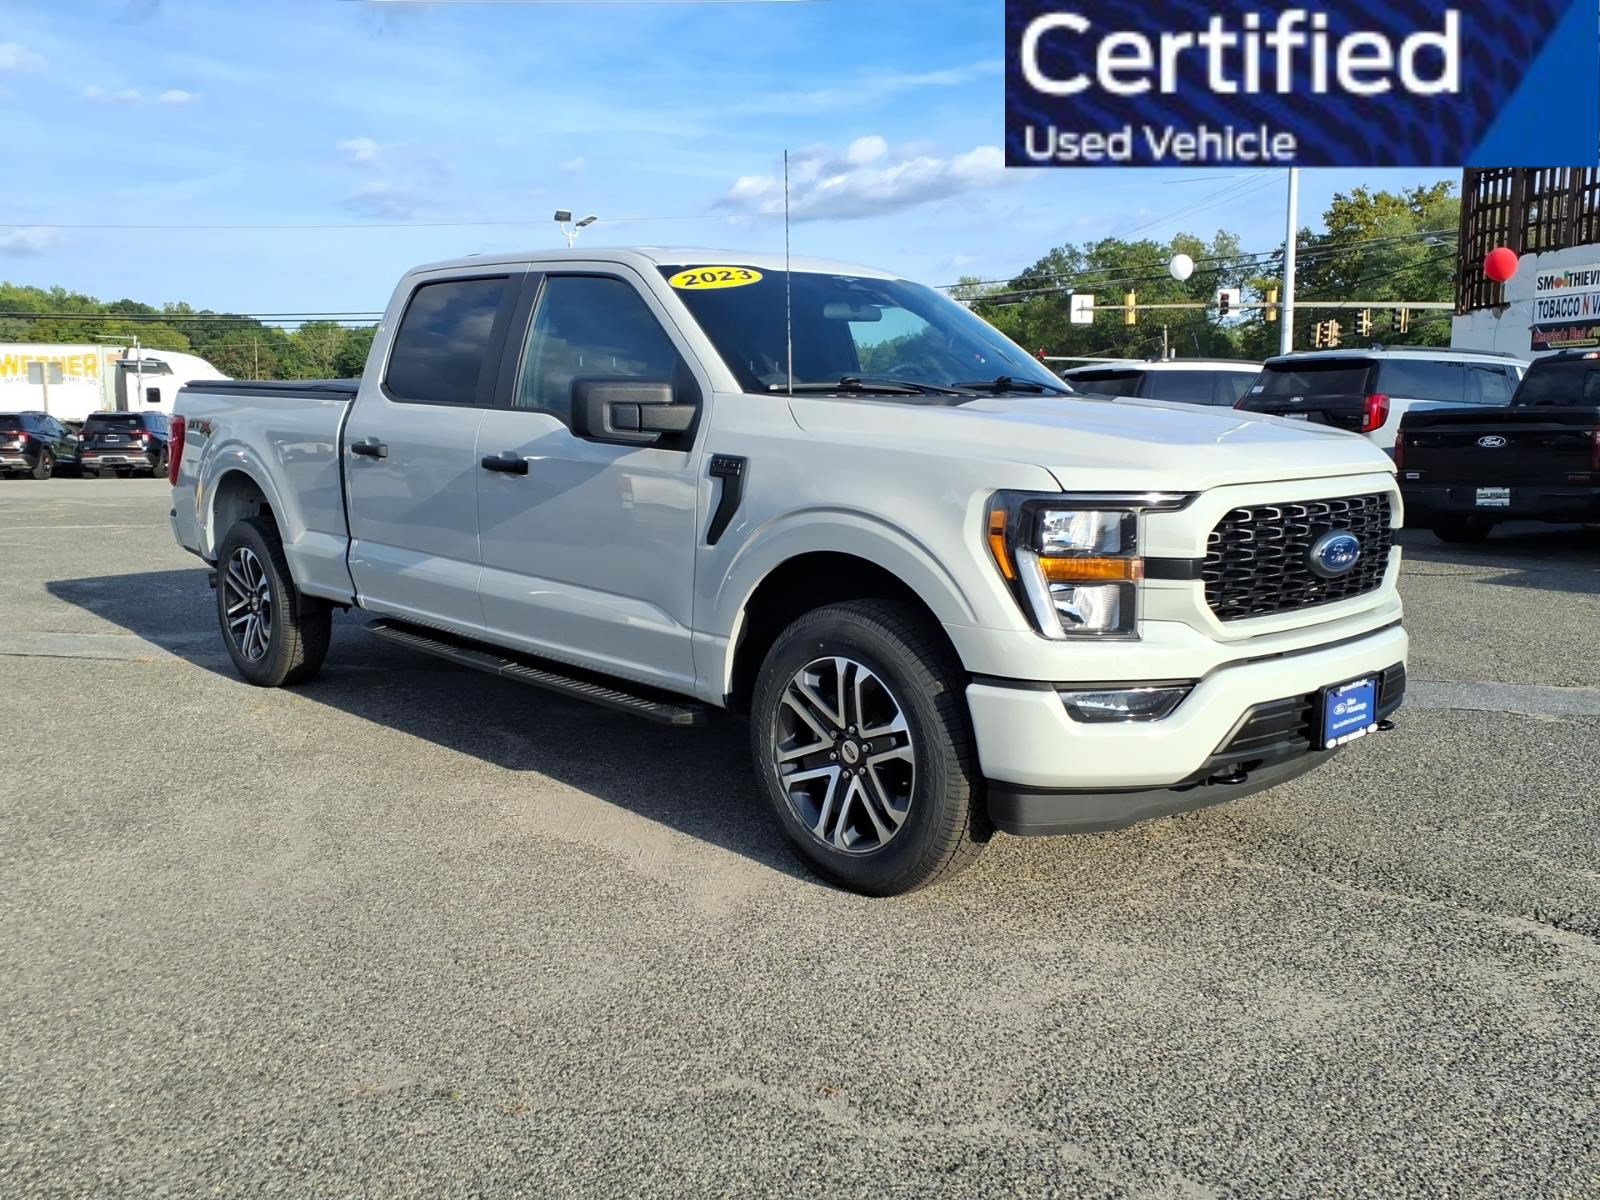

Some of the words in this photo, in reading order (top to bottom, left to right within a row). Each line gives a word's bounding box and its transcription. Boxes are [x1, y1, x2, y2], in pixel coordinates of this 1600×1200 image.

[682, 270, 753, 286] 2023
[1538, 297, 1580, 319] TOBACCO
[1583, 295, 1590, 316] N
